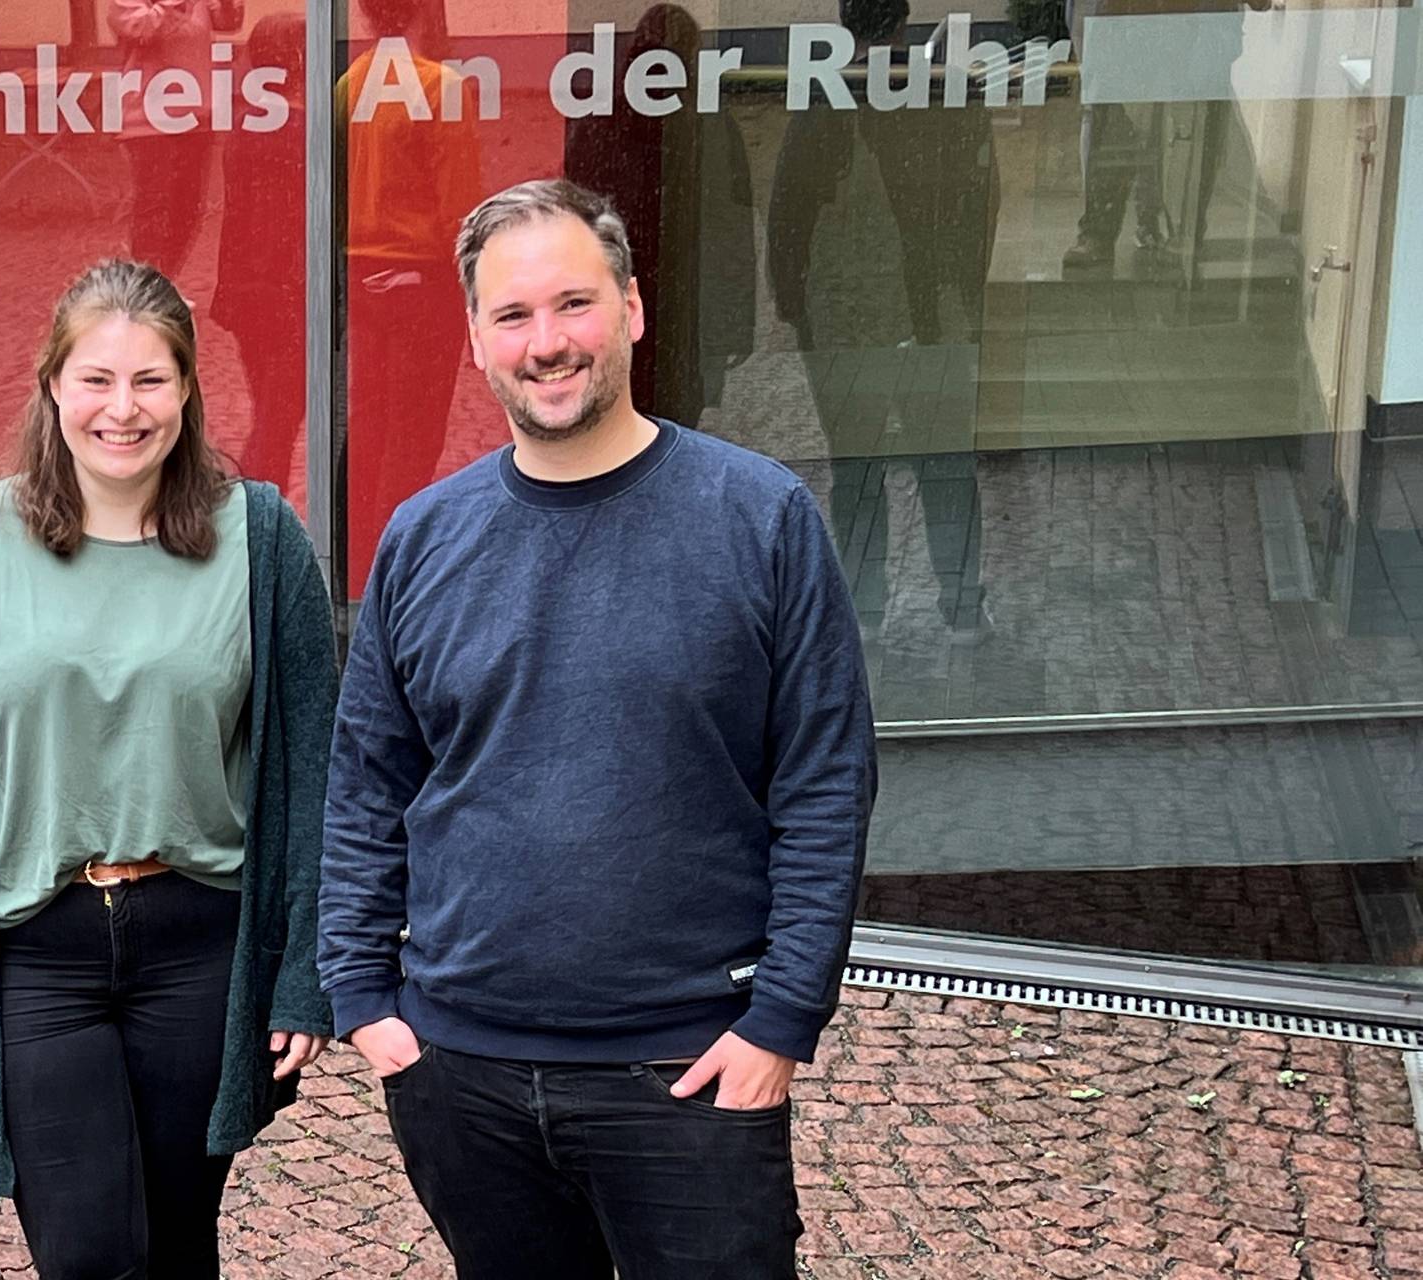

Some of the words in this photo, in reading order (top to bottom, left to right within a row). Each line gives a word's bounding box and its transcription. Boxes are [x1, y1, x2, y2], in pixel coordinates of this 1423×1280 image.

[351, 36, 501, 122] An
[549, 22, 743, 118] der
[786, 12, 1070, 111] Ruhr
